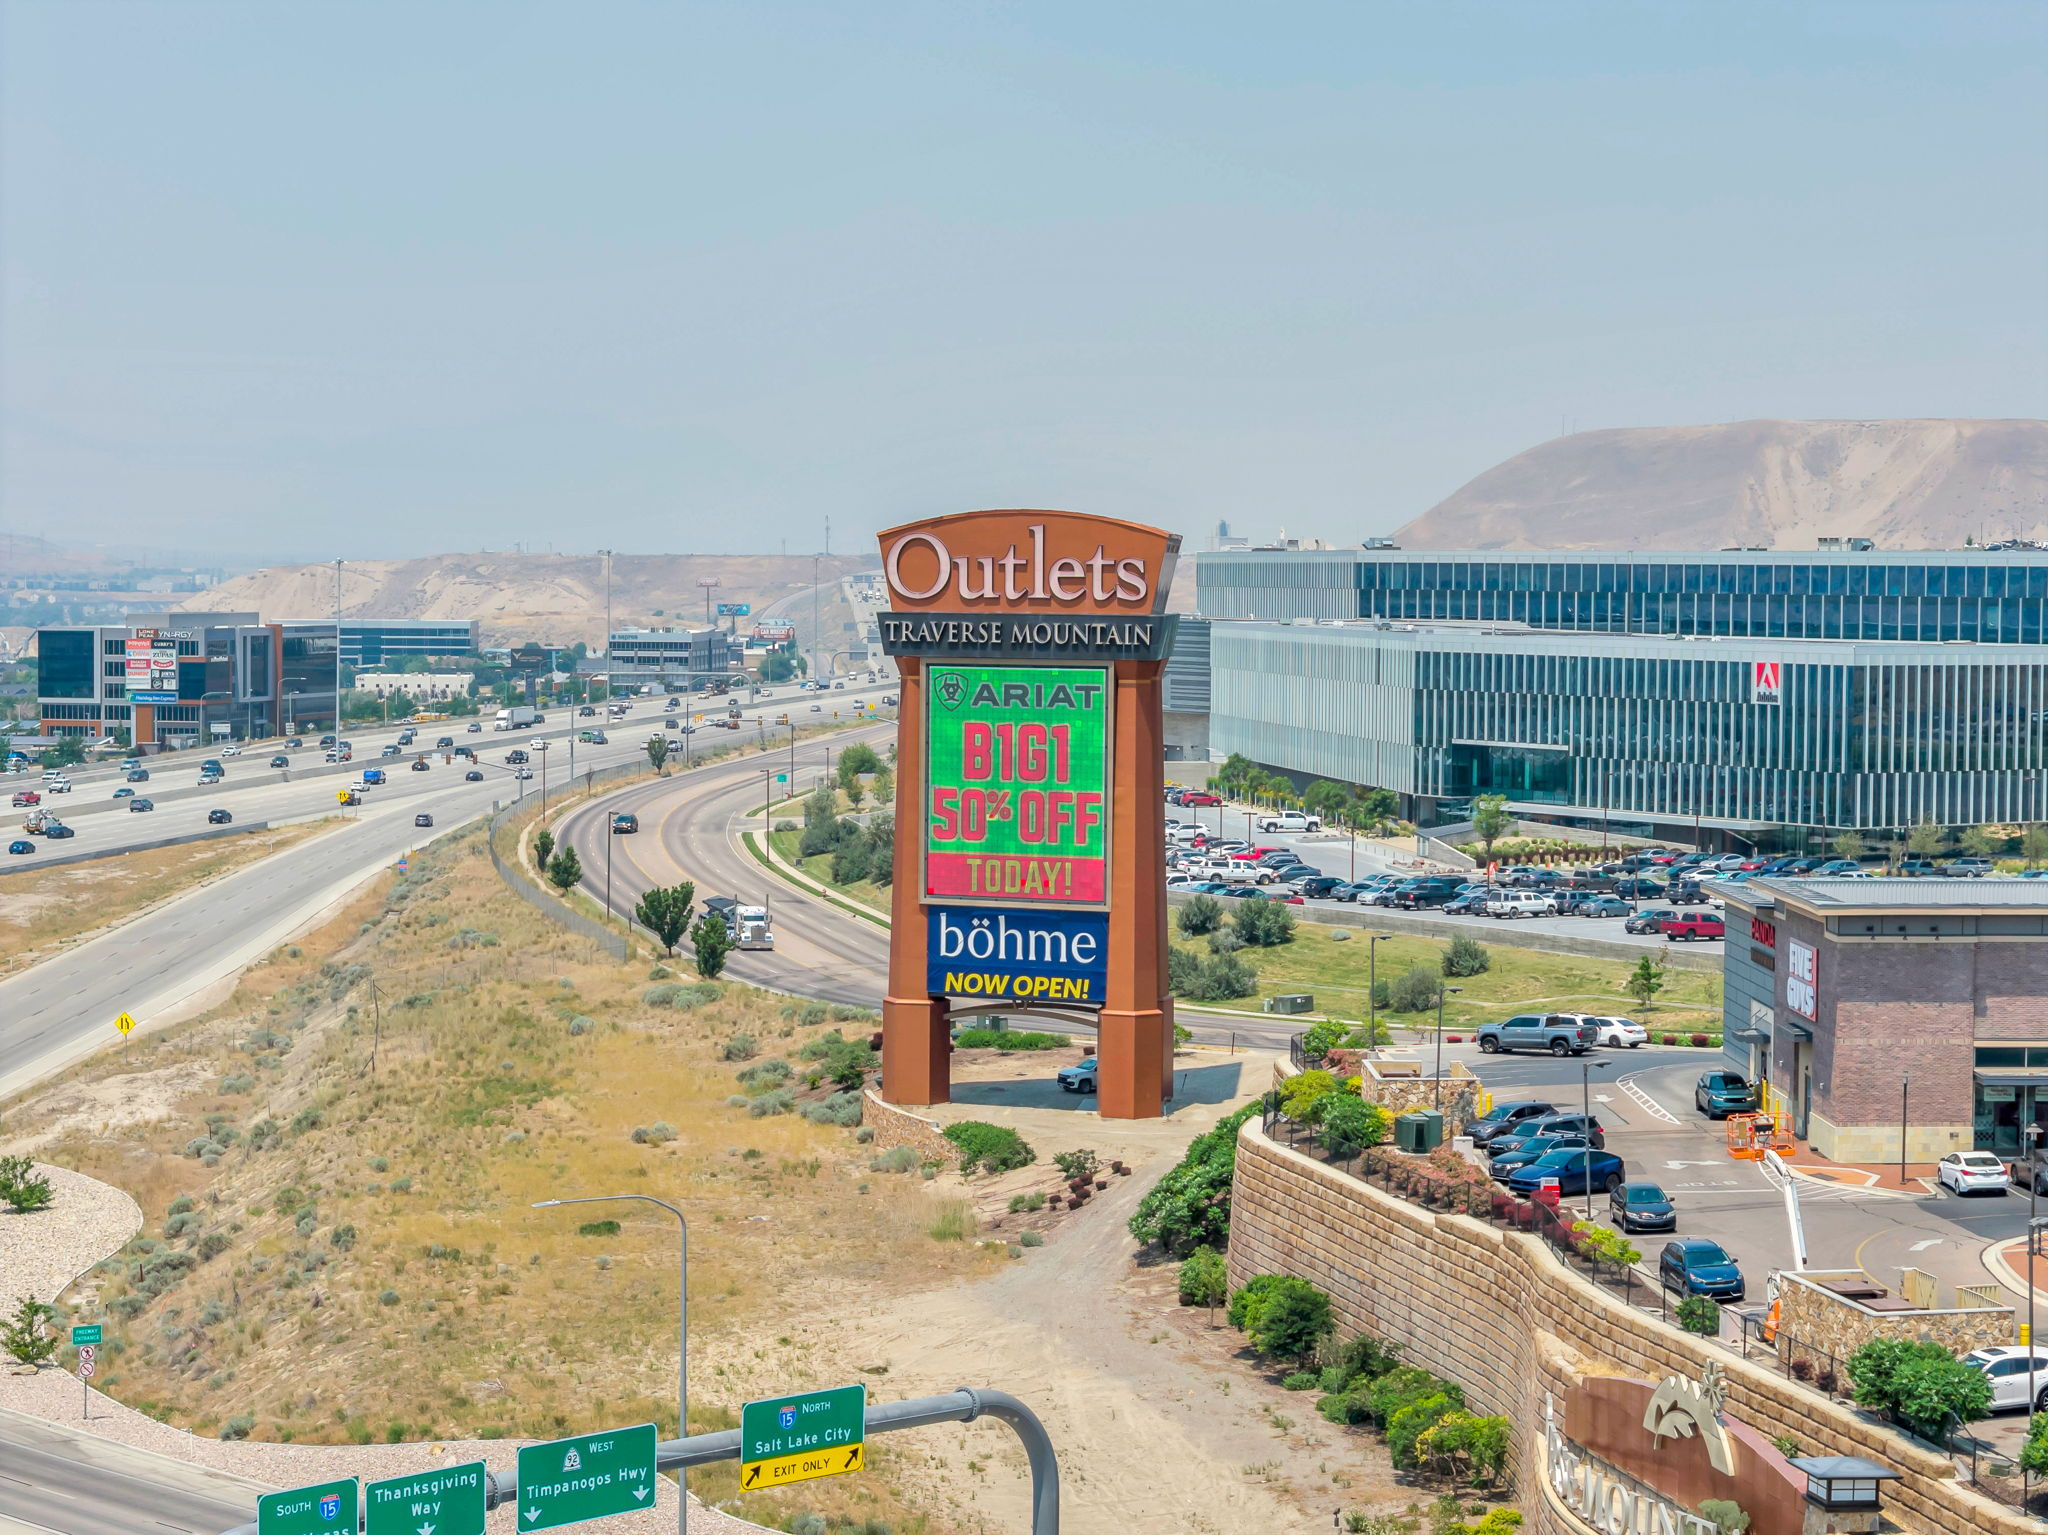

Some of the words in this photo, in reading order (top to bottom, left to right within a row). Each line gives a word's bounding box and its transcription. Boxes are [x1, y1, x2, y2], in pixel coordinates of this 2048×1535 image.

[886, 523, 1148, 601] Outlets
[884, 620, 1002, 644] TRAVERSE
[1011, 623, 1153, 646] MOUNTAIN
[970, 683, 1102, 710] ARIAT
[961, 720, 1071, 784] B1G1
[931, 787, 1013, 842] 50%
[1018, 790, 1102, 847] OFF
[966, 858, 1072, 896] TODAY!
[939, 912, 1097, 965] böhme
[1751, 917, 1776, 949] PANDA
[944, 972, 1010, 995] NOW
[1013, 975, 1090, 999] OPEN!
[781, 1413, 793, 1426] 15
[755, 1438, 781, 1454] Salt
[788, 1433, 818, 1449] Lake
[825, 1427, 851, 1443] City
[567, 1453, 578, 1465] 92
[774, 1465, 797, 1478] EXIT
[803, 1458, 830, 1472] ONLY
[375, 1473, 478, 1503] Thanksgiving
[526, 1474, 612, 1500] Timpanogos
[618, 1466, 648, 1484] Hwy
[322, 1503, 336, 1517] 15
[411, 1502, 441, 1518] Way
